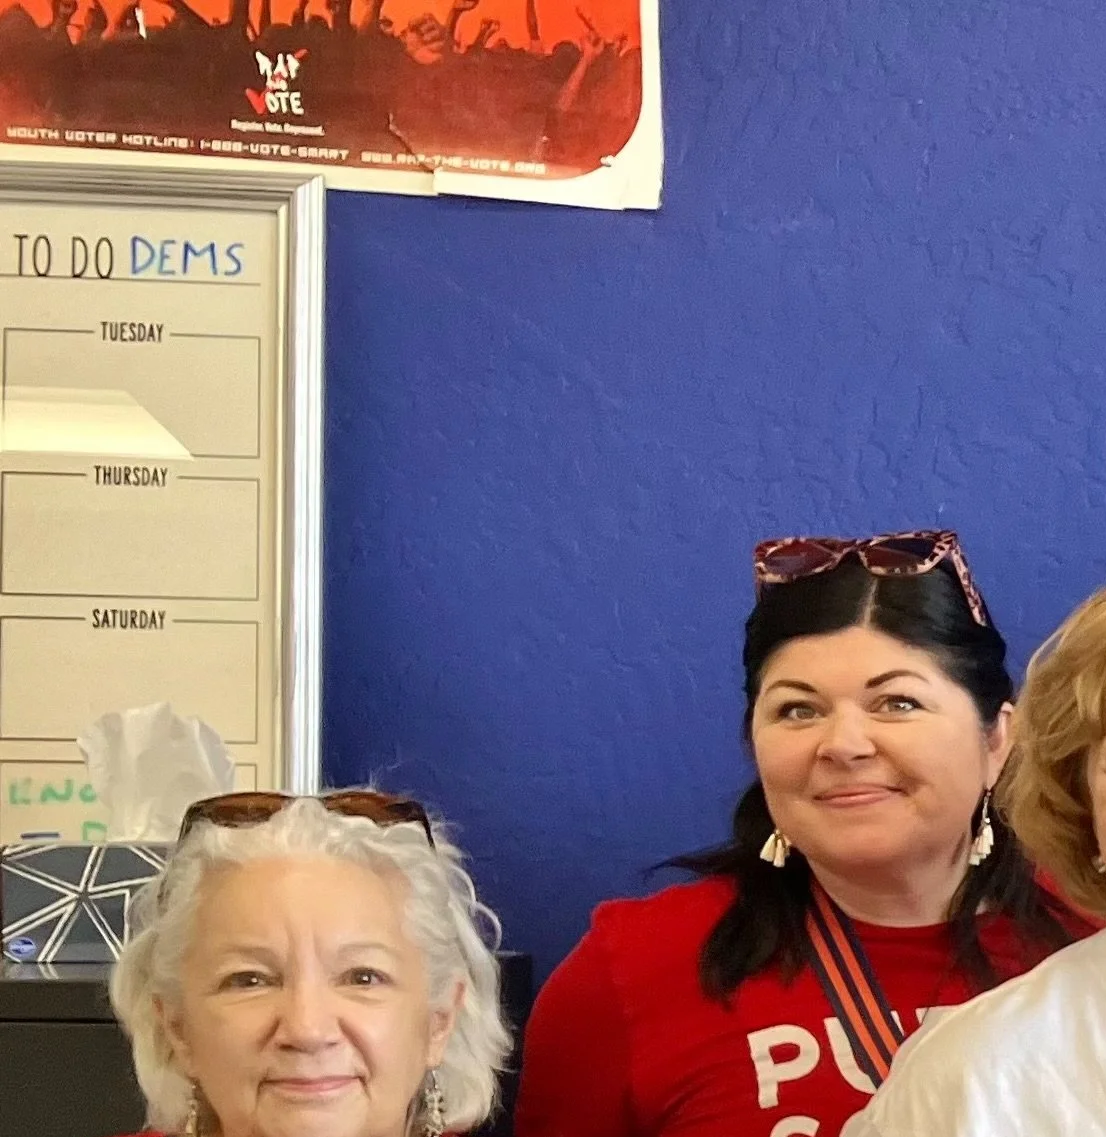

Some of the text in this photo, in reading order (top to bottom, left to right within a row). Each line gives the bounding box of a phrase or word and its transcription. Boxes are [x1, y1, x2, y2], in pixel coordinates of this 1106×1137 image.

[7, 126, 60, 140] YOUTH
[65, 129, 117, 144] VOTER
[13, 233, 115, 279] TO DO
[130, 235, 245, 276] DEMS
[100, 321, 165, 343] TUESDAY
[93, 464, 168, 487] THURSDAY
[92, 608, 166, 630] SATURDAY
